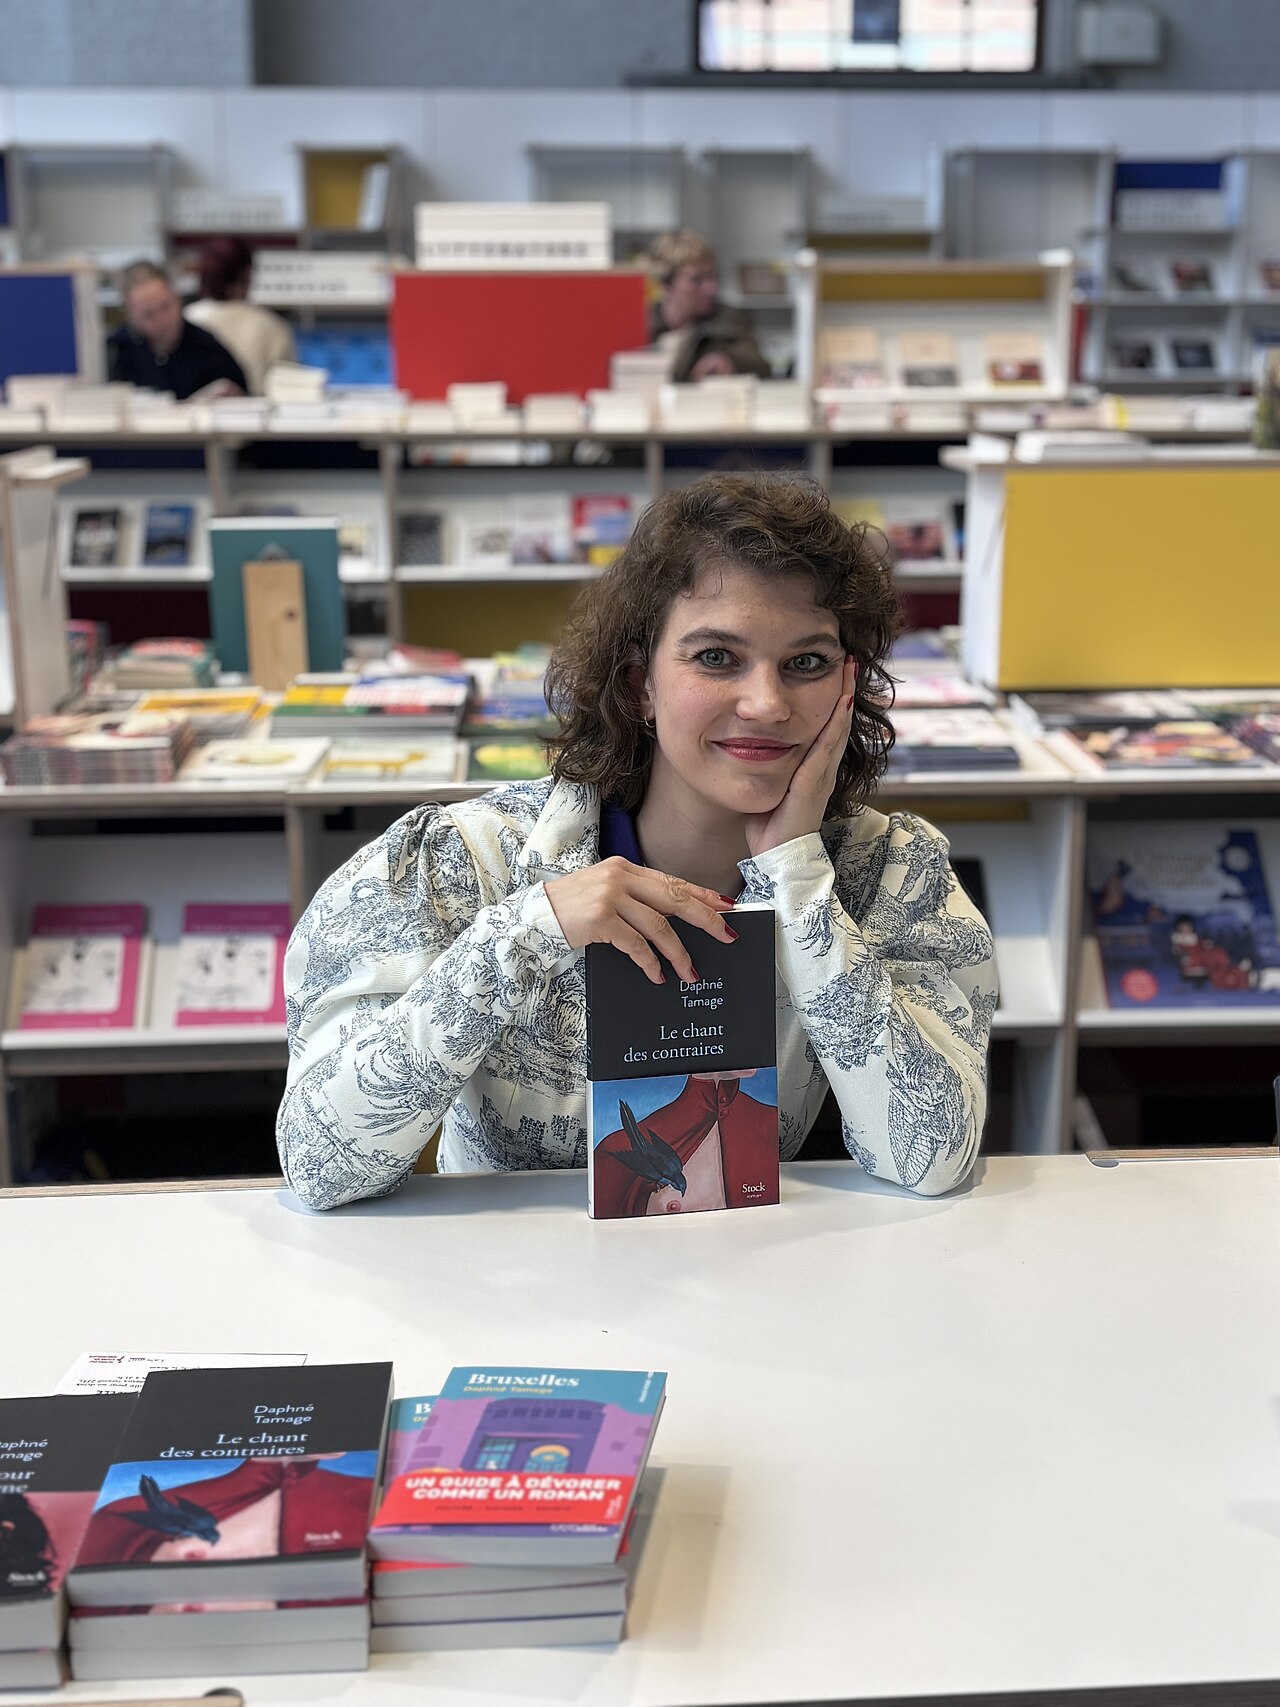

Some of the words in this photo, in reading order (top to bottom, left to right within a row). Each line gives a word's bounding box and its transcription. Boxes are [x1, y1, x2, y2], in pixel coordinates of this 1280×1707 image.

[680, 977, 724, 995] Daphné
[681, 996, 724, 1010] Tamage
[660, 1025, 678, 1040] Le
[682, 1022, 724, 1038] chant
[623, 1047, 648, 1062] des
[652, 1042, 724, 1060] contraires
[742, 1181, 766, 1193] Stock
[468, 1373, 580, 1387] Bruxelles
[254, 1403, 315, 1415] Daphné
[254, 1416, 312, 1425] Tamage
[0, 1439, 48, 1451] aphné
[216, 1433, 243, 1445] Le
[249, 1432, 309, 1444] chant
[0, 1452, 43, 1461] mage
[160, 1447, 195, 1458] des
[201, 1445, 305, 1457] contraires
[406, 1477, 436, 1489] UN
[440, 1476, 501, 1489] GUIDE
[506, 1475, 521, 1489] À
[525, 1475, 621, 1491] DÉVORER
[413, 1488, 490, 1500] COMME
[493, 1489, 524, 1500] UN
[527, 1490, 605, 1501] ROMAN
